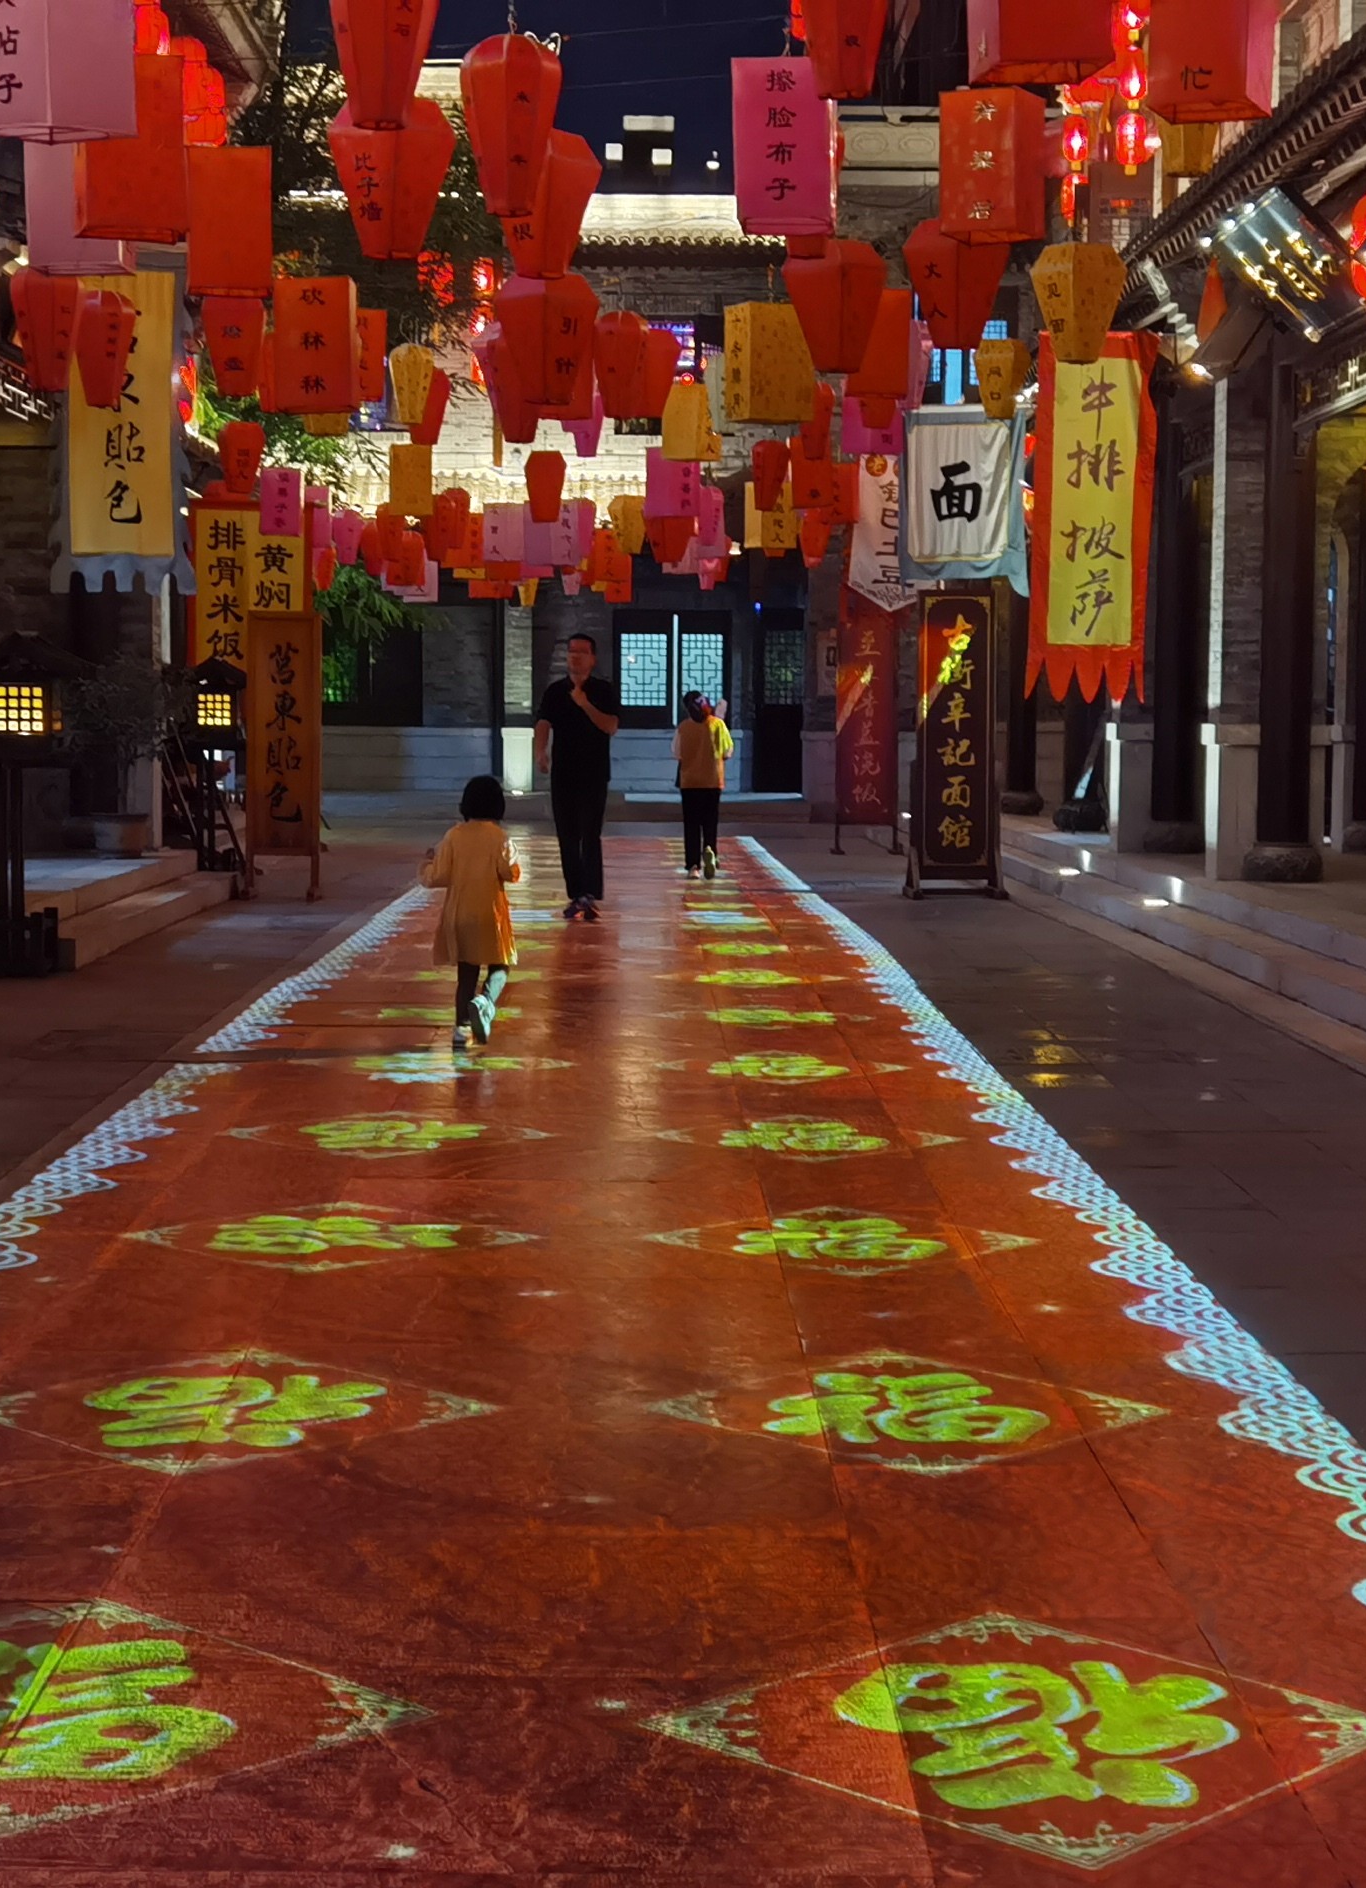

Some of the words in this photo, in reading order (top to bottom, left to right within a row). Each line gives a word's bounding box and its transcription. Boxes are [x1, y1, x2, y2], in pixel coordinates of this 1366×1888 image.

[765, 69, 796, 201] 擦脸布子
[930, 460, 983, 523] 面
[1059, 366, 1126, 637] 牛排披萨
[206, 519, 247, 661] 排骨米饭
[254, 543, 296, 610] 黄焖
[833, 1659, 1240, 1809] 福
